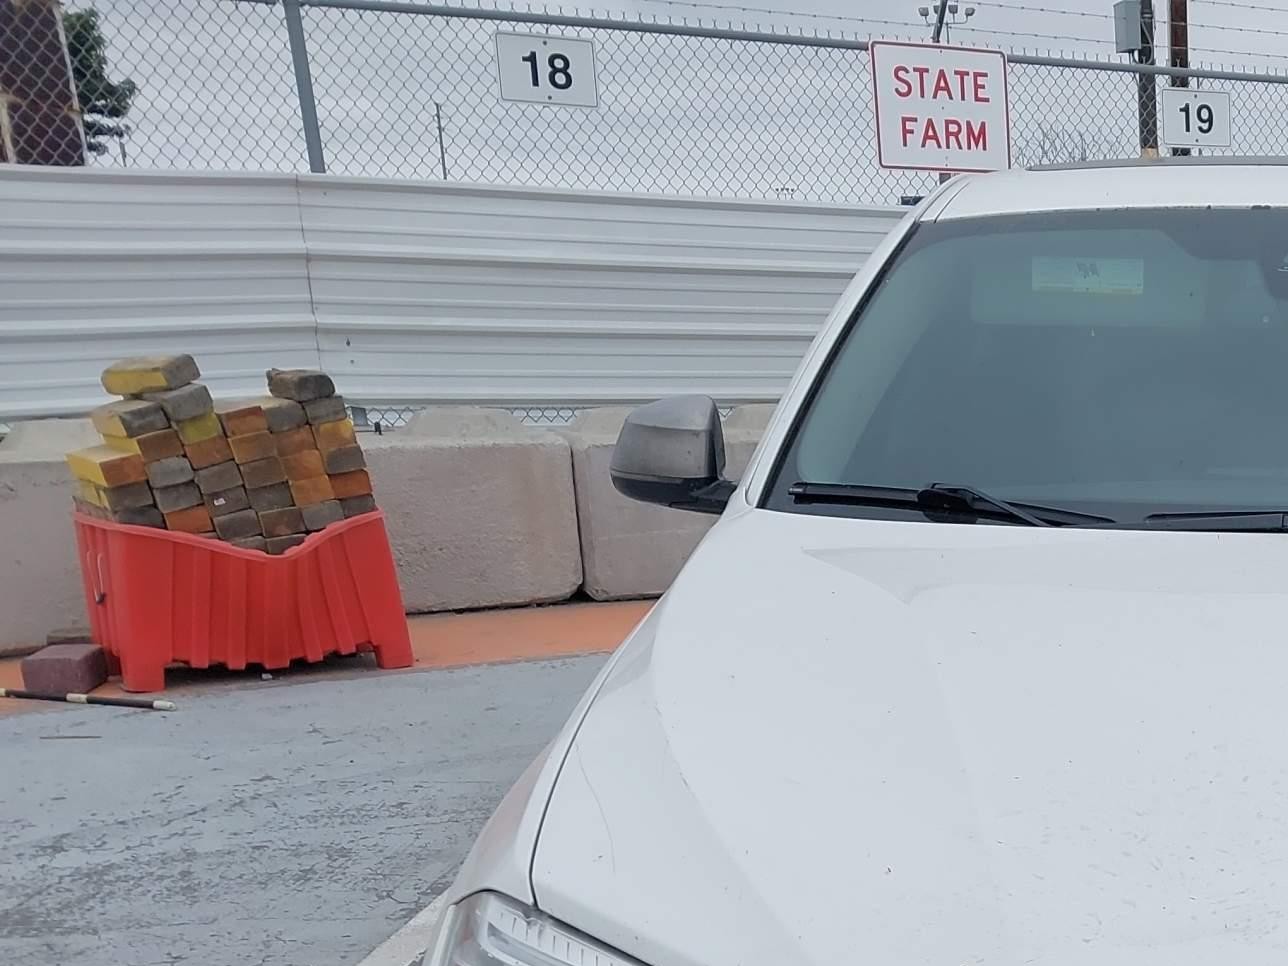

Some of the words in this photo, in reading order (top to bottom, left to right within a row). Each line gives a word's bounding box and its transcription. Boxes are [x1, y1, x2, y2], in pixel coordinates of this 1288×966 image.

[521, 51, 573, 90] 18
[893, 65, 990, 103] STATE
[901, 116, 988, 151] FARM
[1179, 102, 1214, 134] 19
